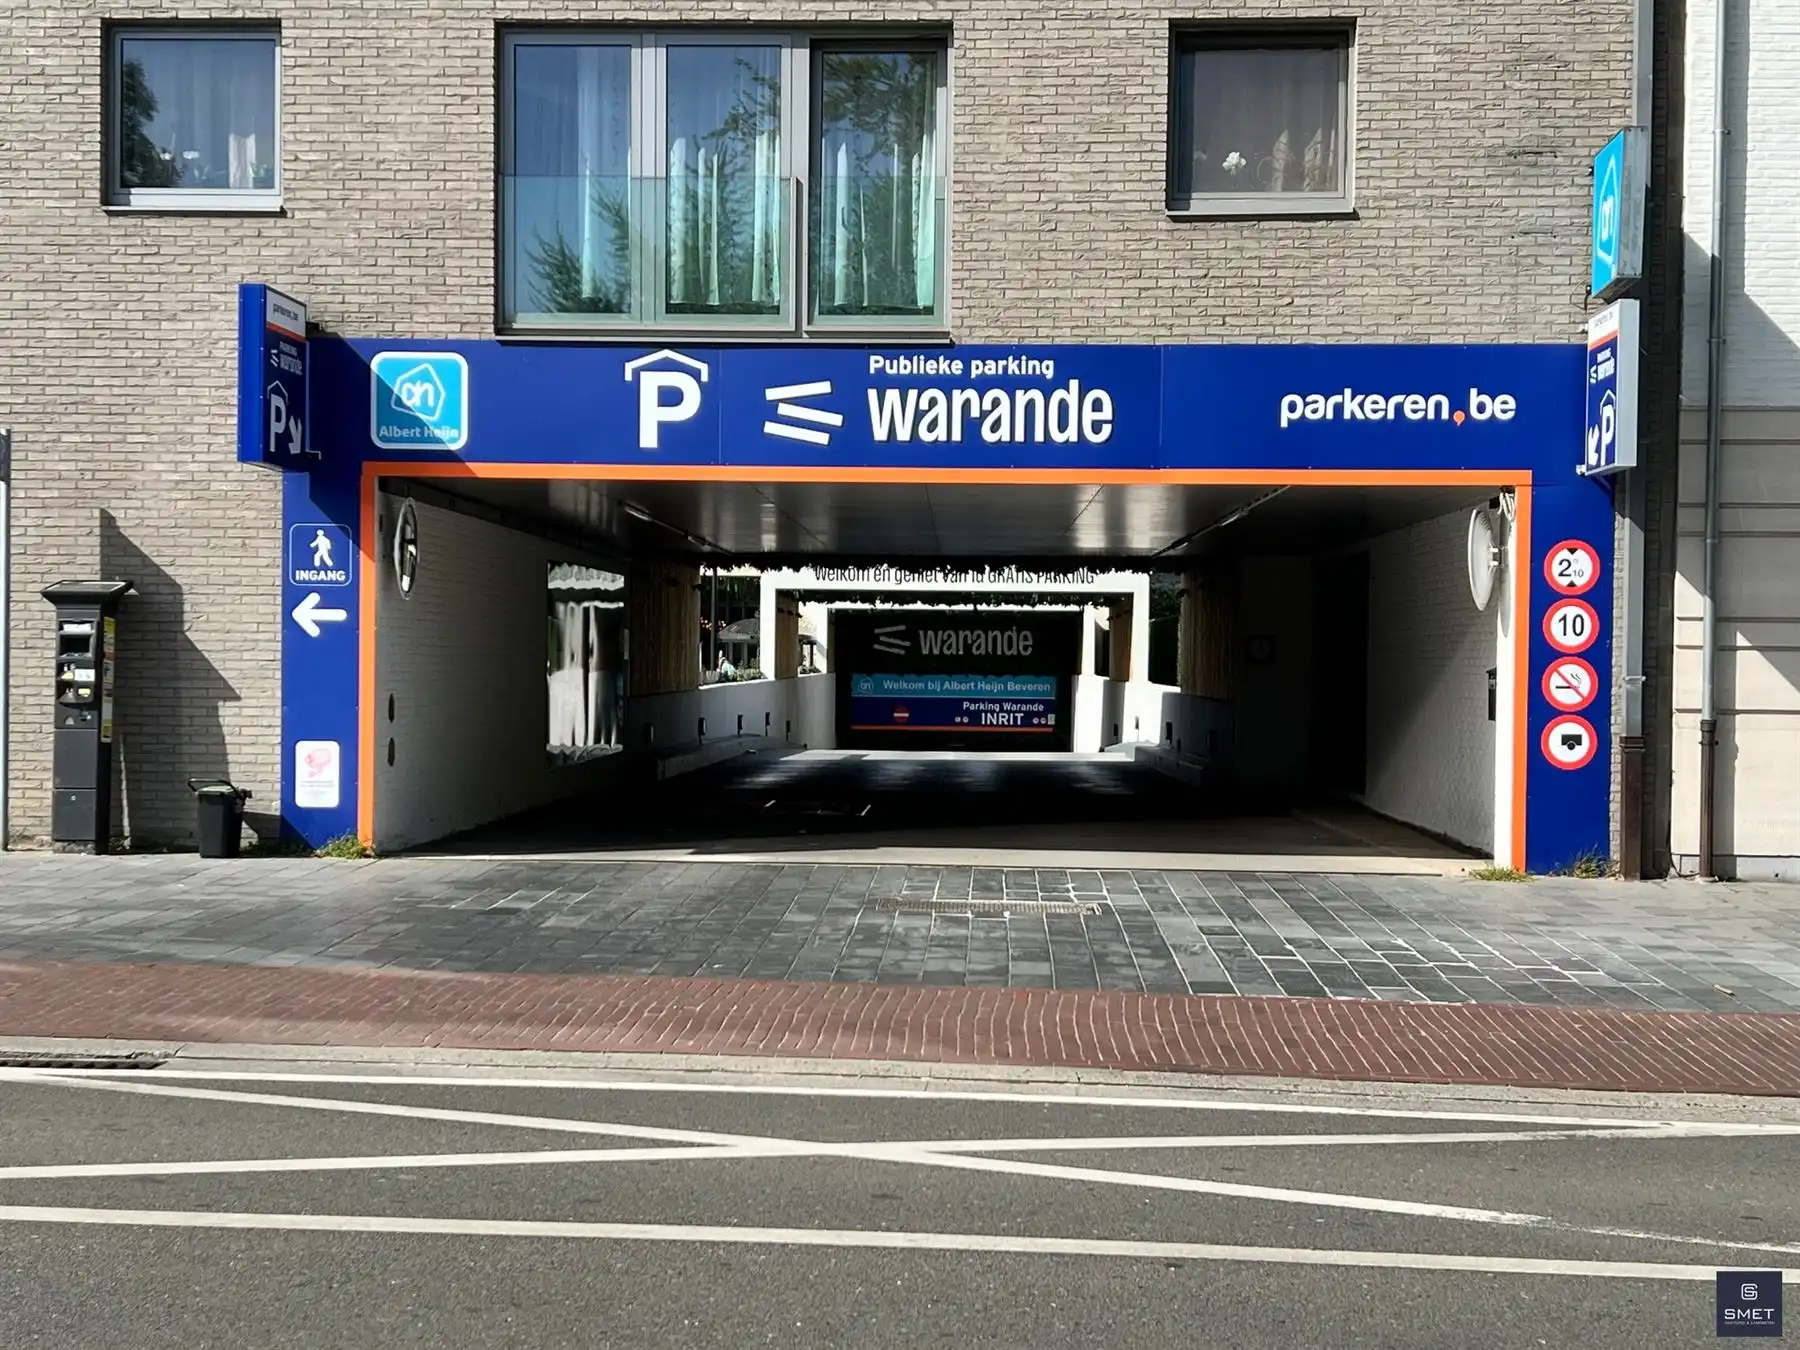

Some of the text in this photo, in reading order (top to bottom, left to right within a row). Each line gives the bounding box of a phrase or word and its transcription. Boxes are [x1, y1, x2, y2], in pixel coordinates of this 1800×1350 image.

[869, 354, 1054, 379] Publieke parking
[638, 370, 701, 449] P
[867, 379, 1113, 443] warande
[269, 393, 287, 453] P
[379, 425, 459, 440] Albert Heijn
[1600, 403, 1615, 466] P
[295, 569, 346, 581] INGANG
[1558, 613, 1585, 637] 10
[918, 626, 1033, 656] warande
[882, 679, 1051, 693] Welkom bij Albert Heijn Beveren
[963, 701, 1044, 712] Parking Warande
[981, 712, 1024, 725] INRIT
